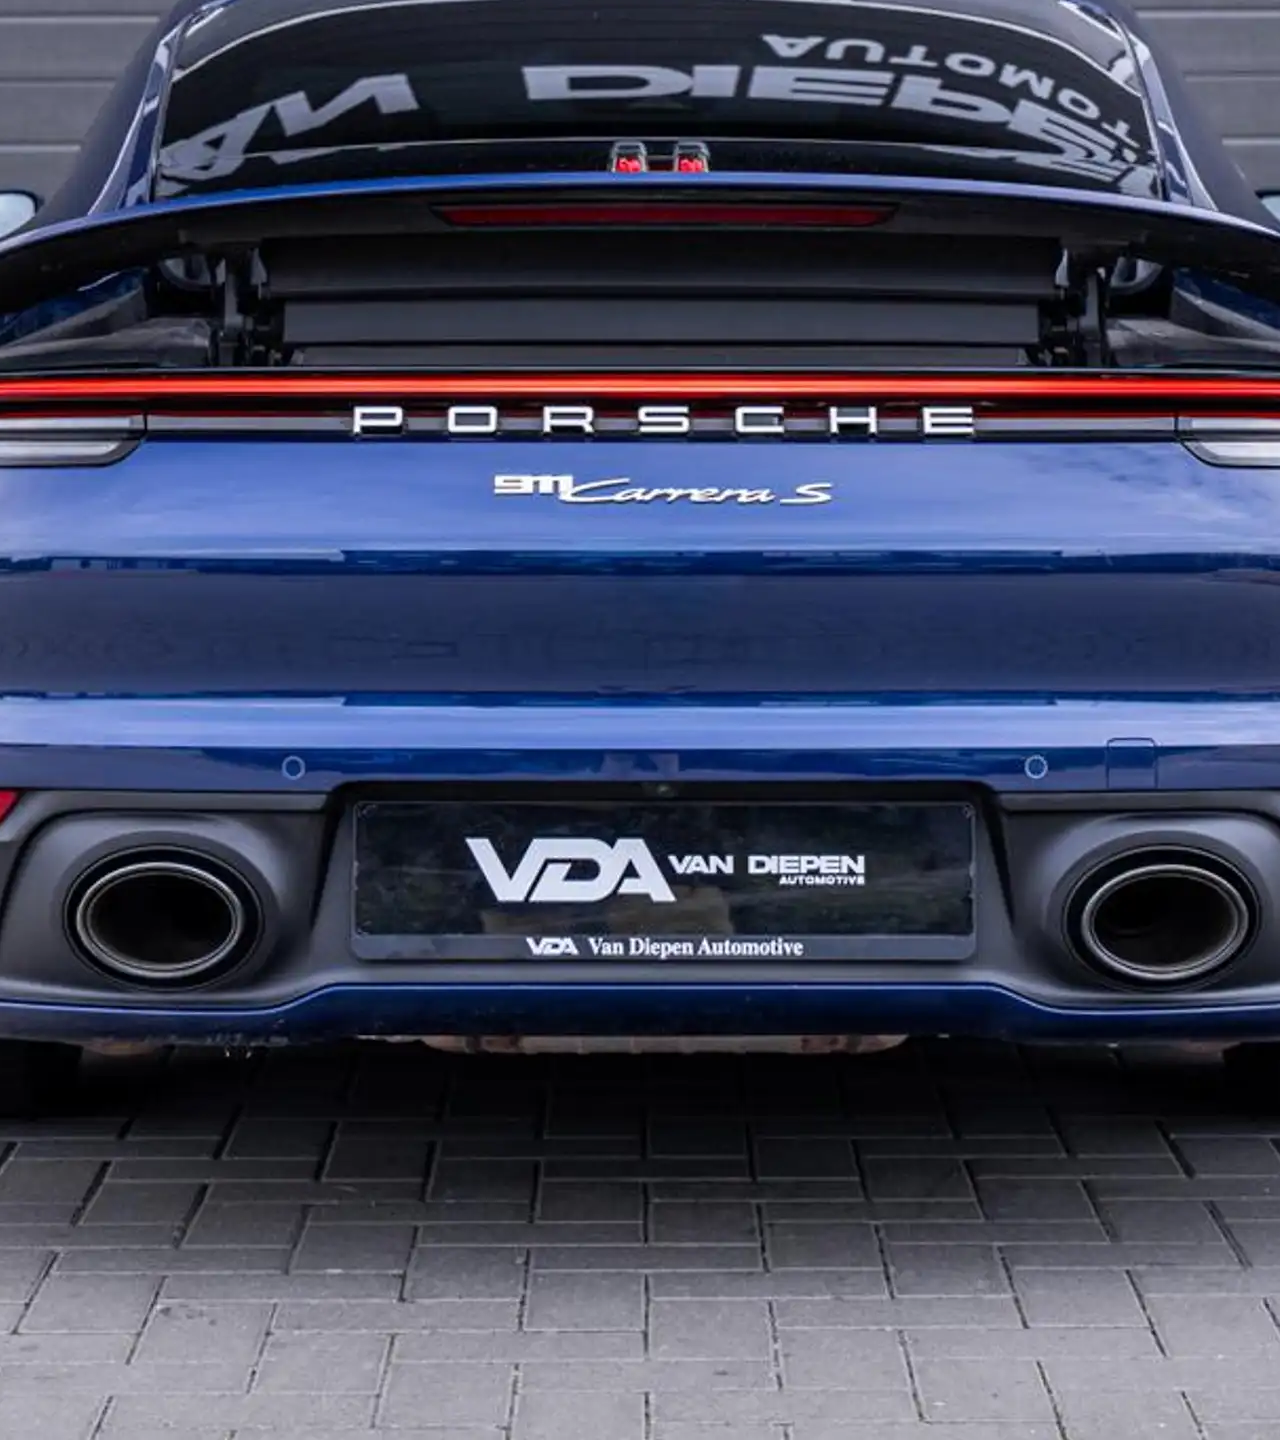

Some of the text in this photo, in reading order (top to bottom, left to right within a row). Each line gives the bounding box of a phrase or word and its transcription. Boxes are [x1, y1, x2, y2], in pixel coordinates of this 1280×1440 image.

[352, 405, 975, 434] PORSCHE
[493, 474, 833, 504] 911 Carrera S
[464, 837, 677, 903] VDA
[668, 855, 866, 875] VAN DIEPEN
[778, 875, 866, 886] AUTOMOTIVE
[525, 936, 804, 960] VDA Van Diepen Automotive
